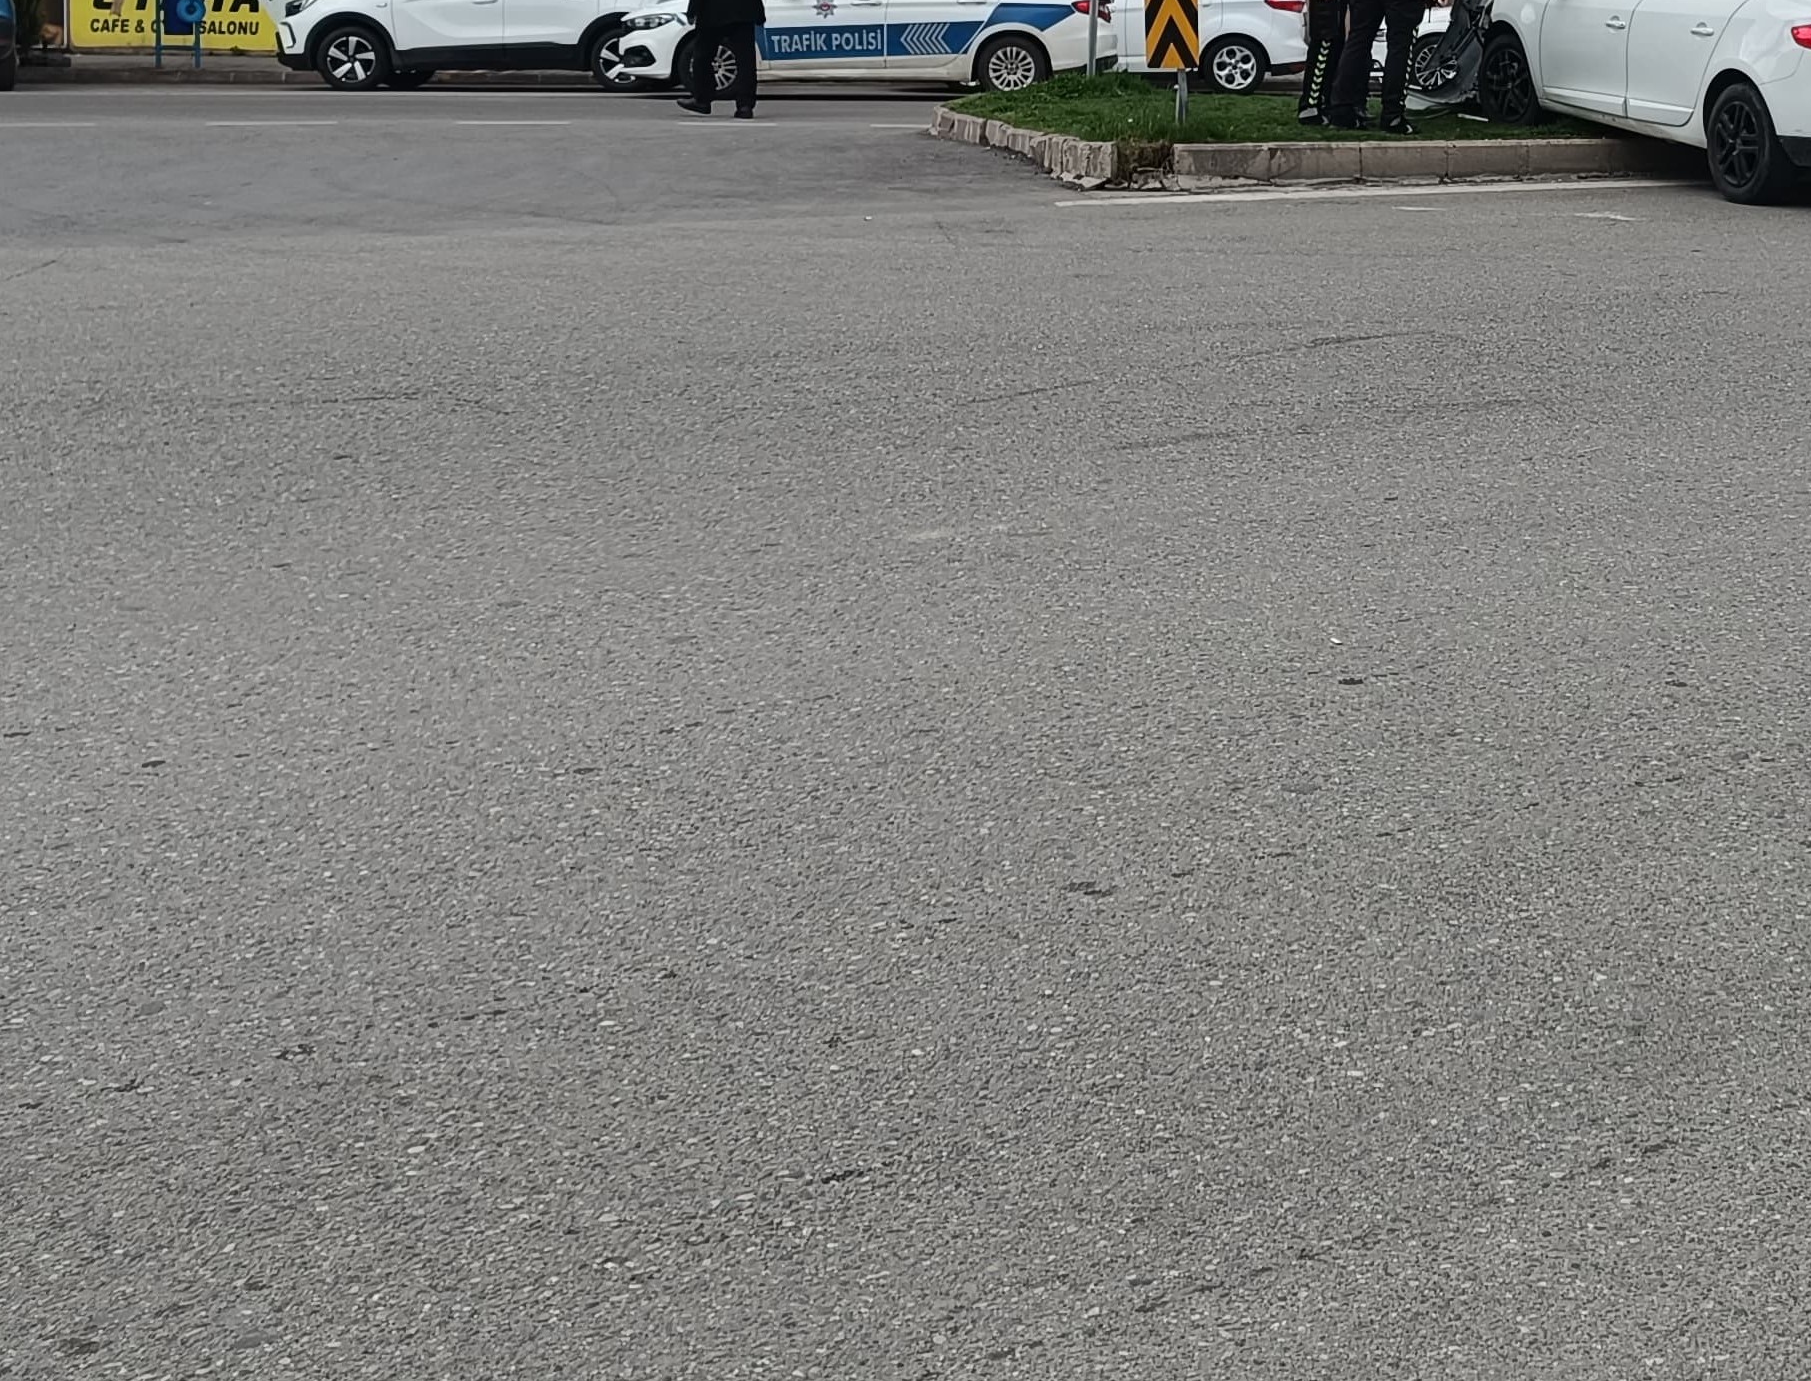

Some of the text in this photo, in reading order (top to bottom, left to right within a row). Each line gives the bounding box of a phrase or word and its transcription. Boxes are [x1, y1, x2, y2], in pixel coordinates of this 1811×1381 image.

[90, 18, 130, 33] CAFE
[134, 19, 145, 34] &
[199, 20, 259, 36] SALONU
[771, 29, 882, 53] TRAFİK POLİSİ
